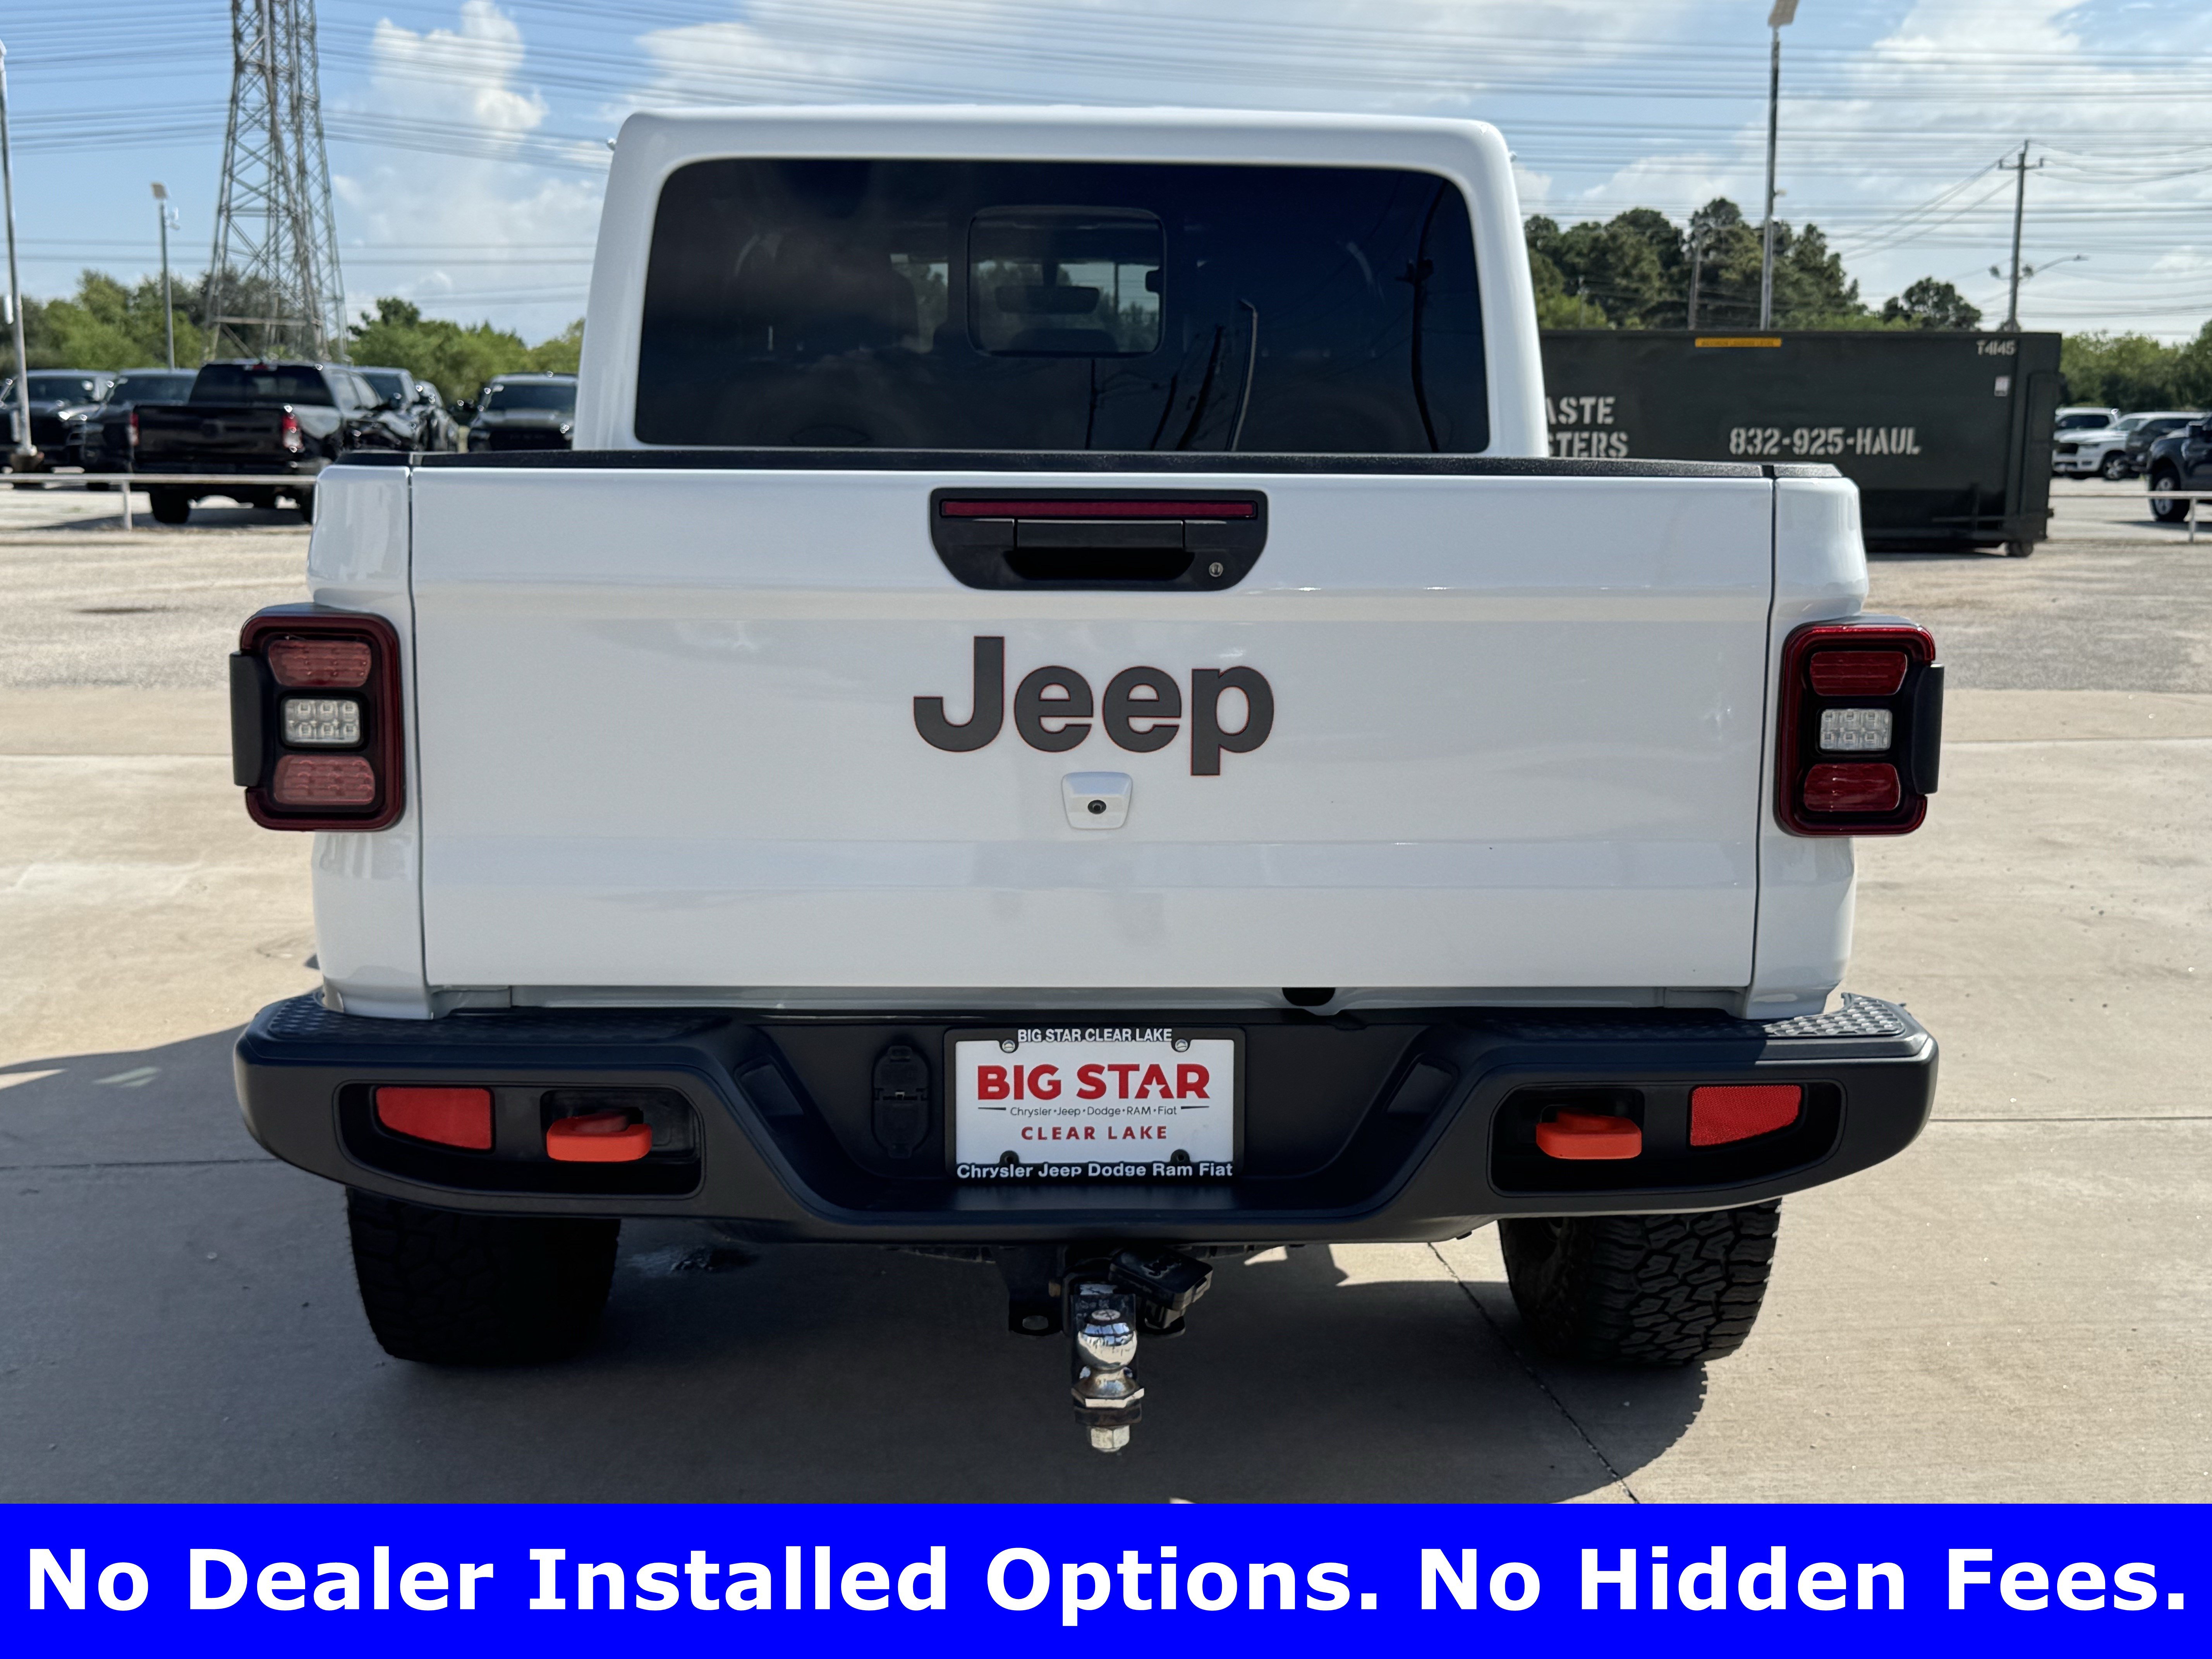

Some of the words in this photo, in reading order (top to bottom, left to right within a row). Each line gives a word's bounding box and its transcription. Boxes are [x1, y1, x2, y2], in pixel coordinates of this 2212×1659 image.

[1729, 427, 1922, 455] 832-925-HAUL
[913, 635, 1274, 776] Jeep
[1018, 1028, 1042, 1042] BIG
[1046, 1028, 1082, 1042] STAR
[1085, 1028, 1133, 1042] CLEAR
[1136, 1028, 1172, 1042] LAKE
[978, 1064, 1061, 1100] BIG
[1077, 1064, 1210, 1099] STAR
[1158, 1106, 1177, 1115] Fiat
[1022, 1127, 1095, 1140] CLEAR
[1108, 1127, 1166, 1139] LAKE
[957, 1164, 1033, 1179] Chrysler
[1038, 1164, 1082, 1178] Jeep
[1088, 1163, 1146, 1177] Dodge
[1153, 1163, 1192, 1176] Ram
[1199, 1163, 1232, 1176] Fiat
